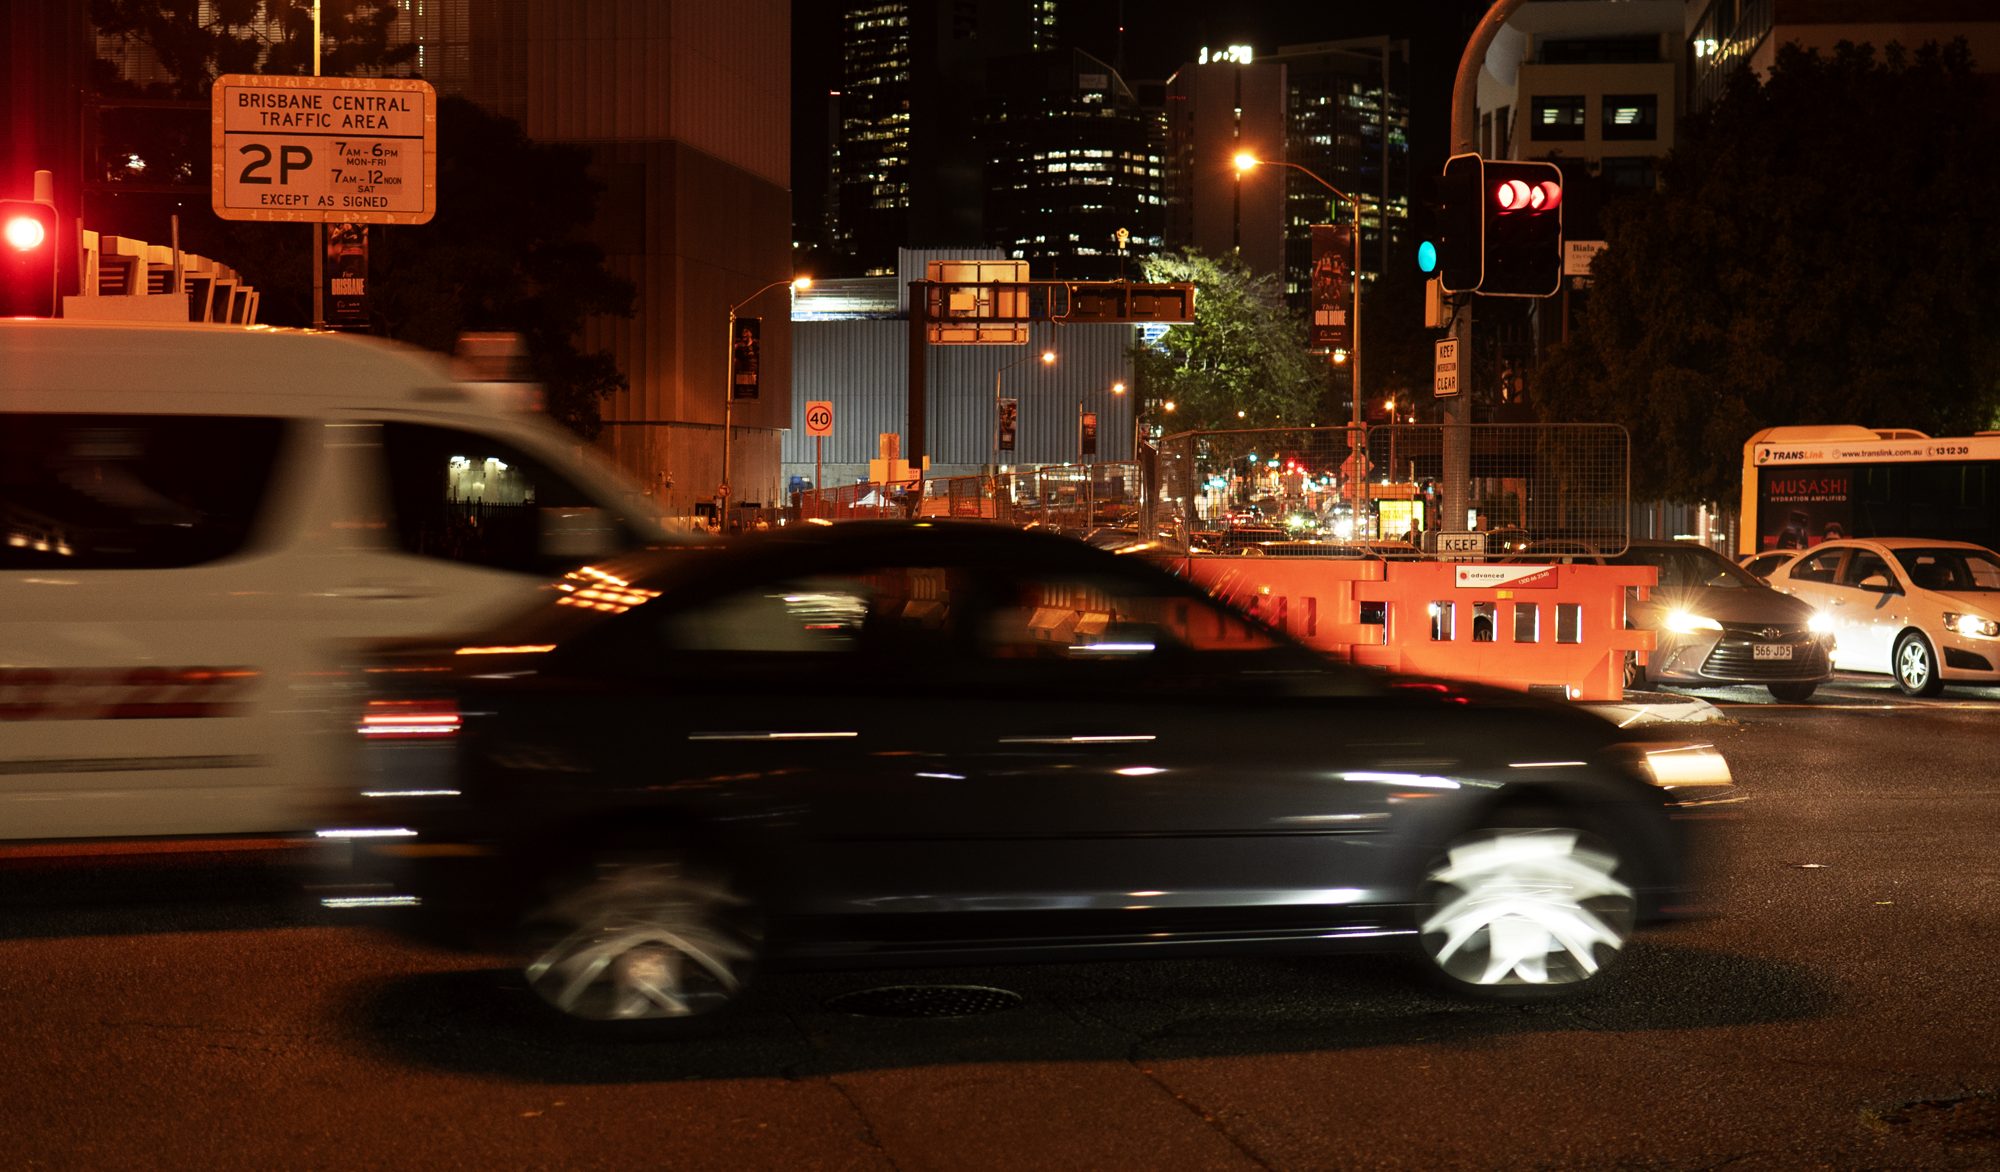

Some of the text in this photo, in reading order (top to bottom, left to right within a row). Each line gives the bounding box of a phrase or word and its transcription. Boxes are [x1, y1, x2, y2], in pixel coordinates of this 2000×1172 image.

[239, 93, 410, 112] BRISBANE CENTRAL
[260, 111, 389, 129] TRAFFIC AREA
[239, 144, 313, 185] 2P
[346, 158, 386, 166] MON-FRI
[357, 185, 375, 193] SAT
[261, 194, 388, 208] EXCEPT AS SIGNED
[331, 278, 364, 295] BRISBANE
[1440, 344, 1455, 358] KEEP
[1437, 376, 1456, 390] CLEAR
[810, 412, 829, 425] 40
[1842, 449, 1923, 457] www.translink.com.au
[1936, 446, 1969, 455] 13 12 30
[1771, 479, 1847, 495] MUSASHI
[1445, 539, 1478, 551] KEEP
